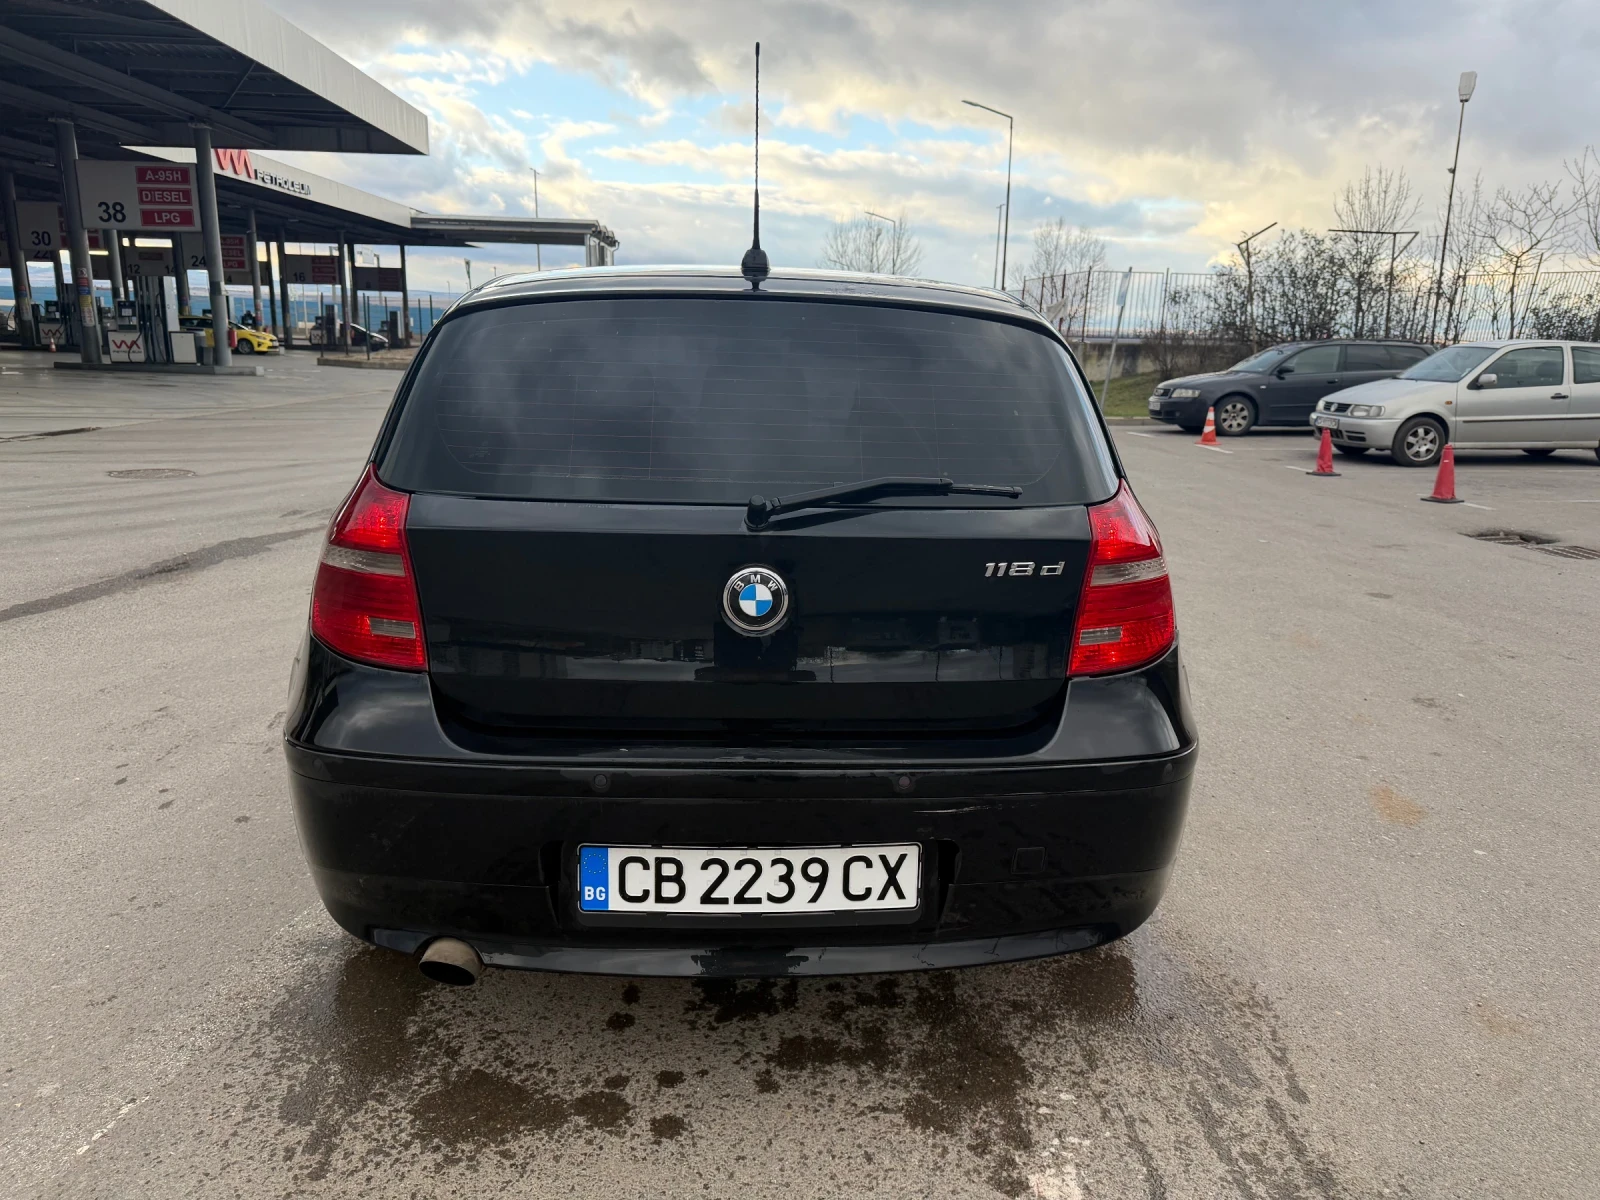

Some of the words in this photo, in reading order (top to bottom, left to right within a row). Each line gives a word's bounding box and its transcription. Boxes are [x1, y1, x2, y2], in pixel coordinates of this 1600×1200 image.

[145, 168, 182, 181] A-95H
[142, 191, 187, 203] DIESEL
[97, 201, 127, 223] 38
[154, 212, 180, 223] LPG
[30, 231, 52, 246] 30
[191, 255, 206, 267] 24
[127, 263, 141, 274] 12
[733, 574, 778, 593] BMW
[584, 886, 606, 901] BG
[618, 855, 687, 904] CB
[699, 857, 829, 905] 2239
[841, 853, 908, 902] CX
